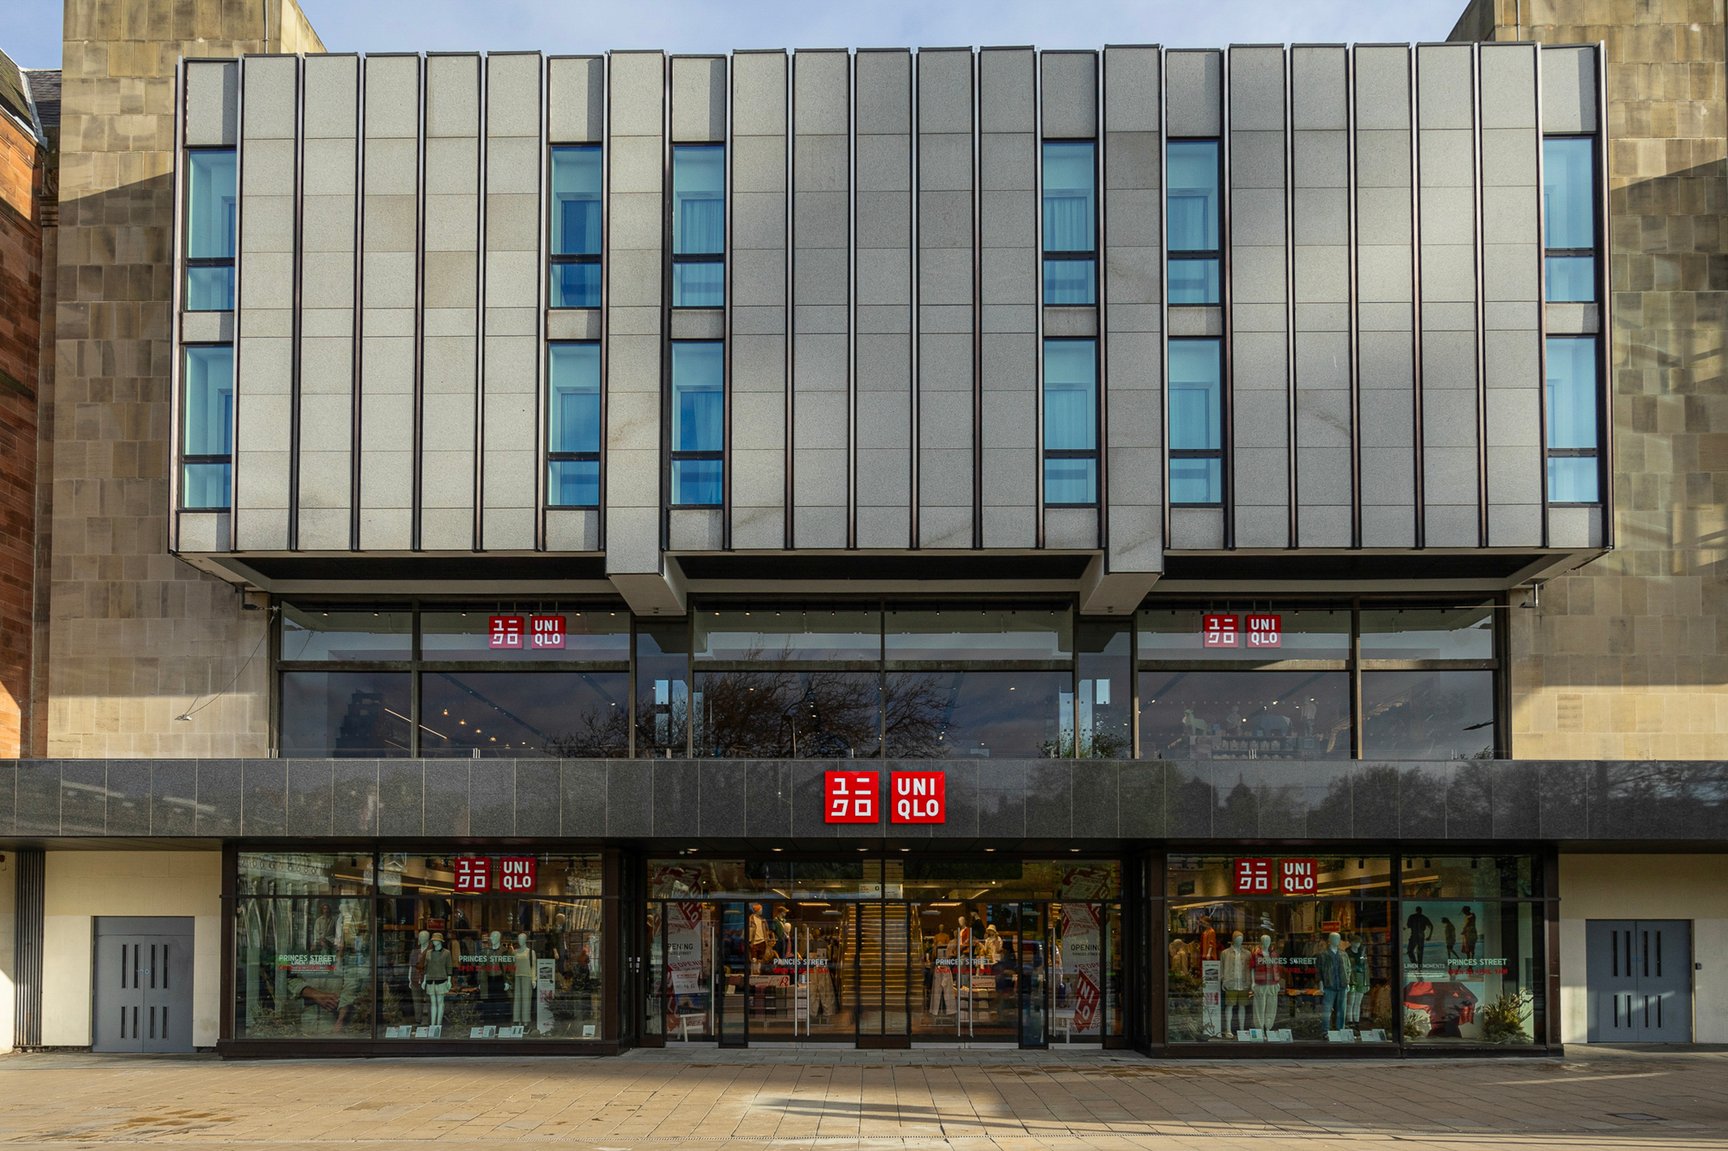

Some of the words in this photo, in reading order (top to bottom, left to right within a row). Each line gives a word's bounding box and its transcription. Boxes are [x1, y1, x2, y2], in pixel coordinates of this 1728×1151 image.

[534, 619, 559, 632] UNI
[1250, 618, 1276, 631] UNI
[534, 633, 561, 647] QLO
[1250, 632, 1278, 646] QLO
[897, 777, 935, 796] UNI
[897, 799, 940, 820] QLO
[502, 860, 531, 874] UNI
[1283, 861, 1312, 876] UNI
[502, 875, 532, 891] QLO
[1283, 877, 1314, 892] QLO
[278, 954, 308, 962] PRINCES
[309, 954, 337, 962] STREET
[458, 955, 488, 963] PRINCES
[489, 955, 516, 963] STREET
[1257, 957, 1288, 965] PRINCES
[1289, 957, 1318, 965] STREET
[1447, 958, 1477, 966] PRINCES
[1479, 958, 1508, 966] STREET
